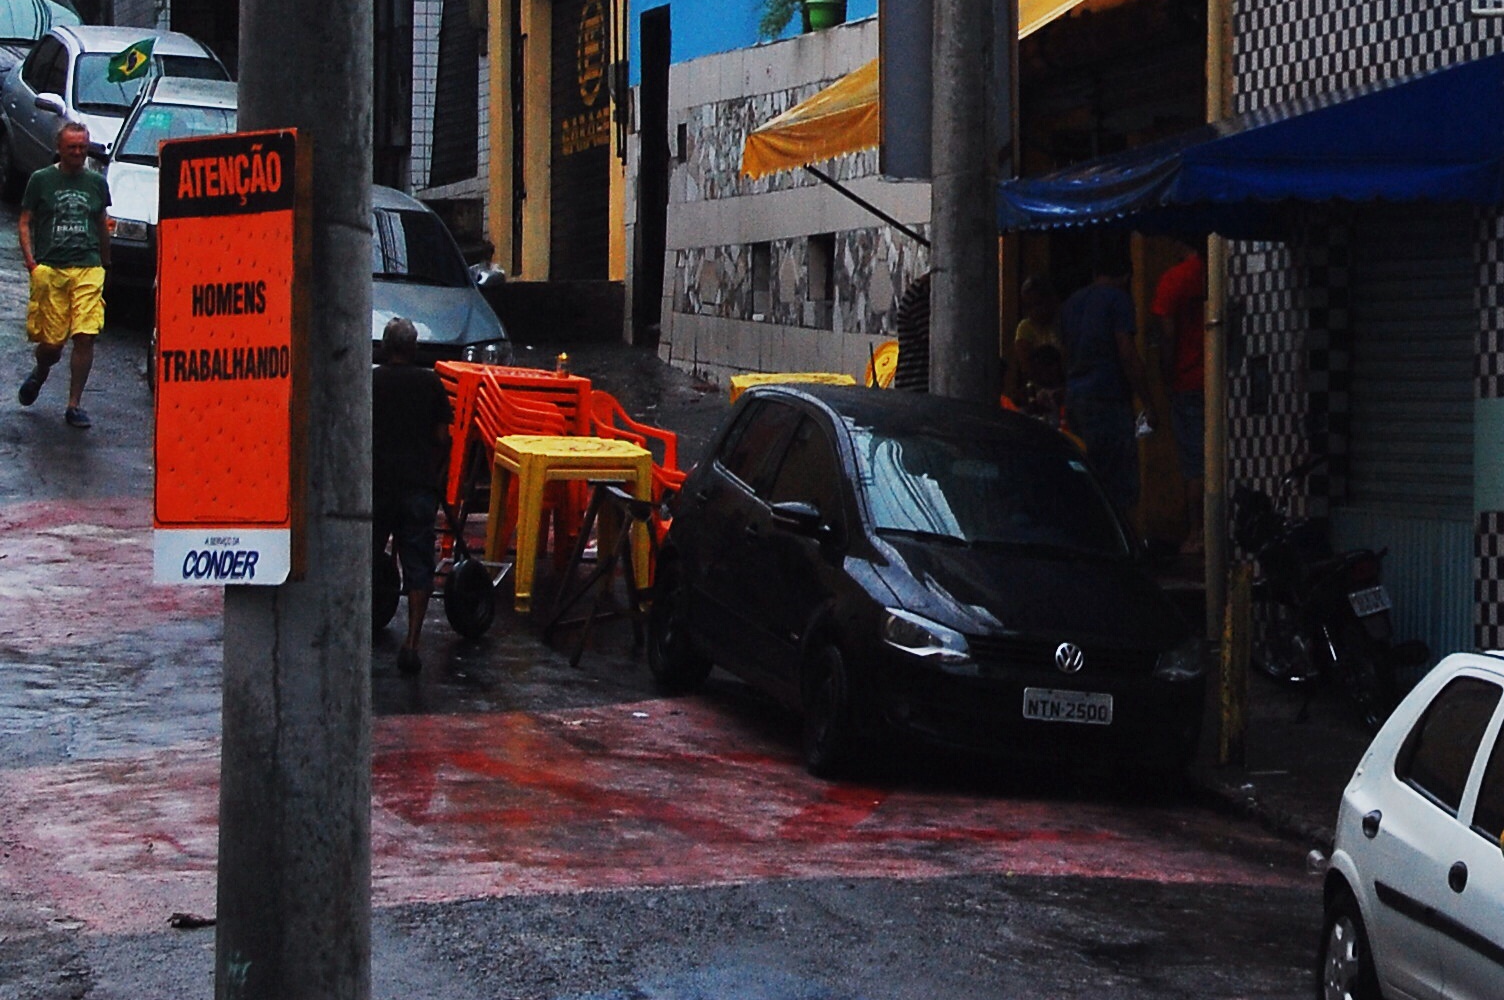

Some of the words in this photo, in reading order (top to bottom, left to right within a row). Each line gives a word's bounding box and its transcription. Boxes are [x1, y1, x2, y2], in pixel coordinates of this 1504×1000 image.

[178, 143, 282, 207] ATENÇÃO
[192, 279, 266, 318] HOMENS
[162, 345, 290, 383] TRABALHANDO
[182, 550, 260, 580] CONDER
